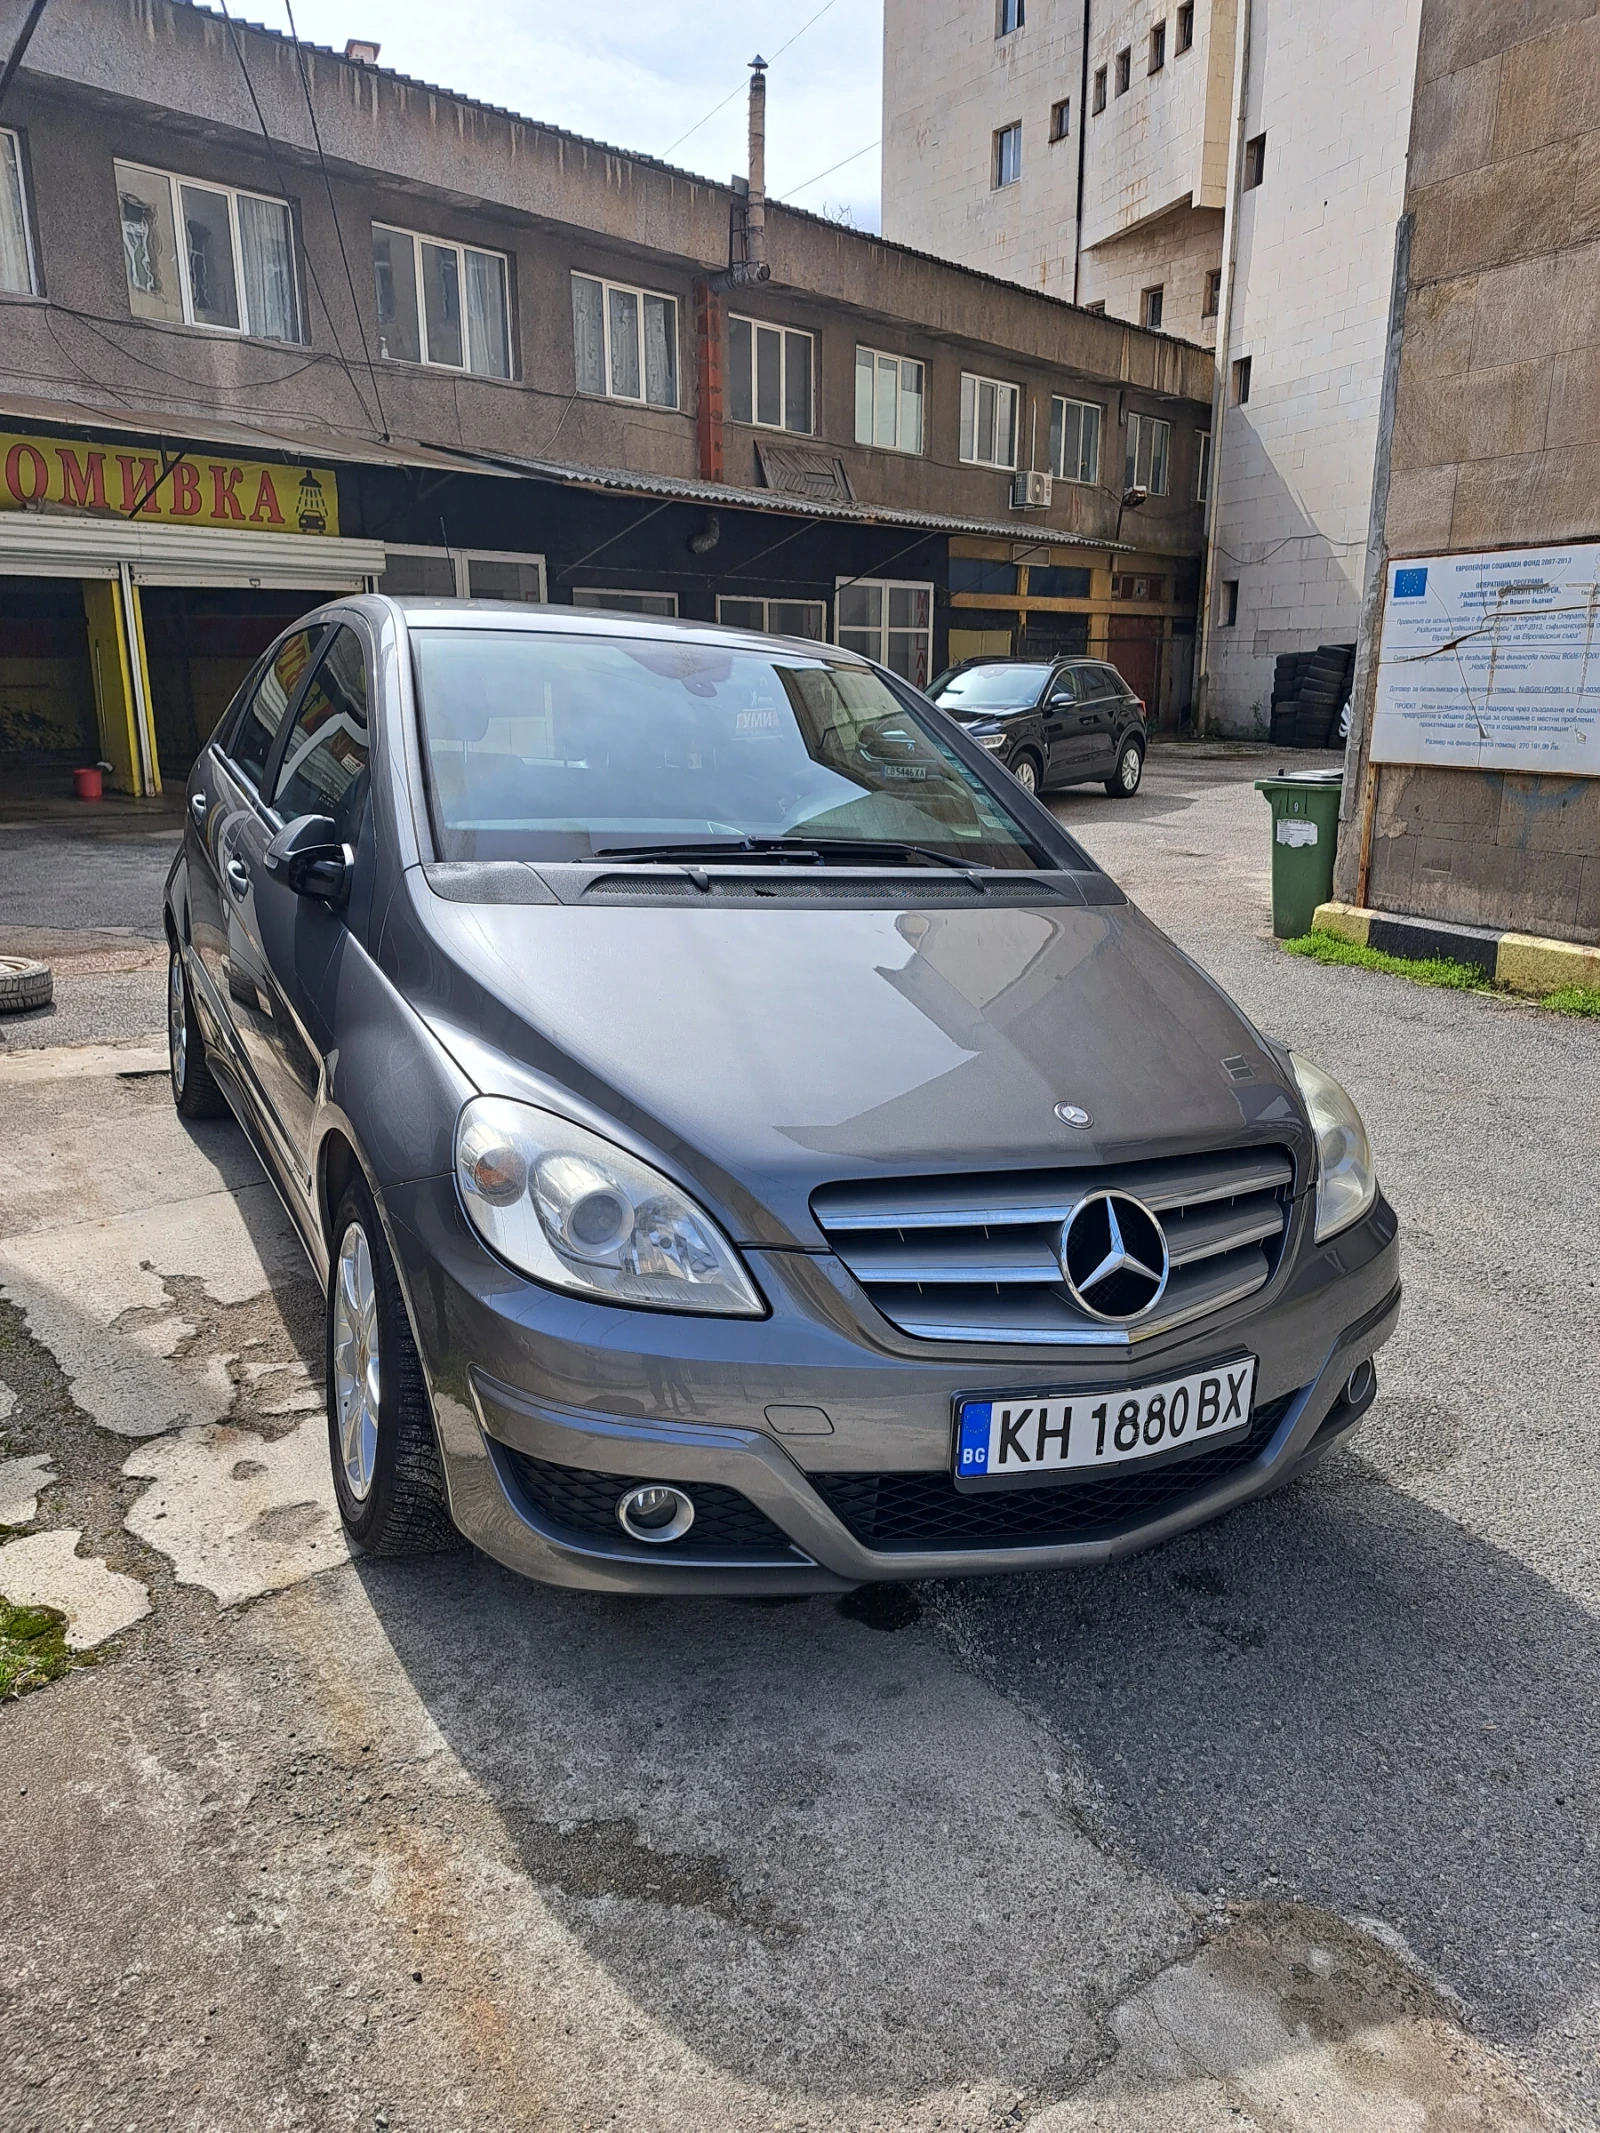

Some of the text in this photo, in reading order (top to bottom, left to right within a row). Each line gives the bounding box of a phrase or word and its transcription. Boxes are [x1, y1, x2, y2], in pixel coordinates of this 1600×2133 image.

[1456, 557, 1572, 572] ЕВРОПЕЙСКИ СОЦИАЛЕН ФОНД 2007-2013
[1389, 685, 1411, 693] Договор
[998, 1368, 1248, 1464] KH 1880 BX
[962, 1447, 985, 1465] BG
